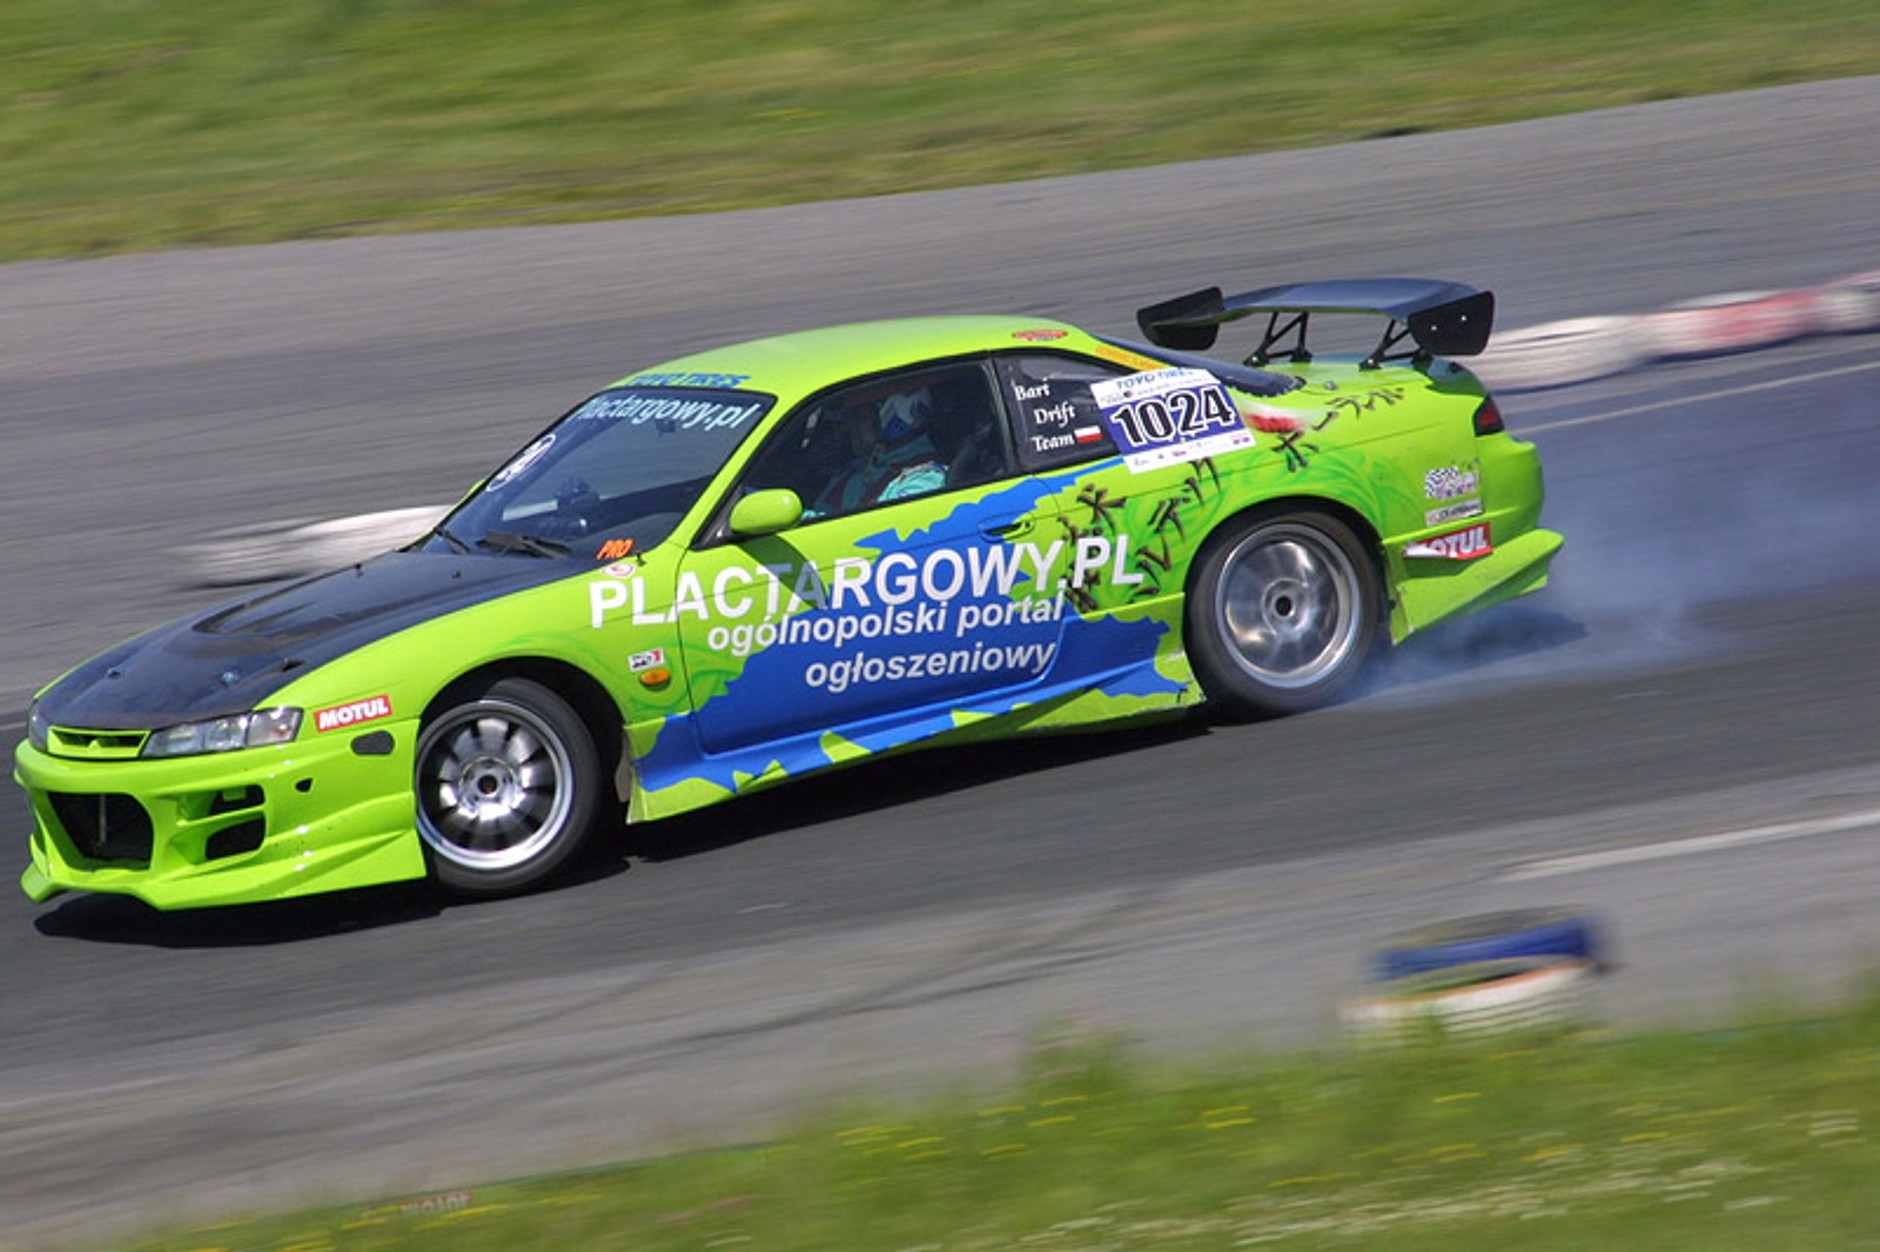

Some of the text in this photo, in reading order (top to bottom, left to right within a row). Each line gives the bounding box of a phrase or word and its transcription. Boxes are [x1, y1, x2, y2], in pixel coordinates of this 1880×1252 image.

[1014, 382, 1050, 401] Bart
[1034, 401, 1076, 427] Drift
[1111, 386, 1234, 446] 1024
[1032, 431, 1075, 451] Team
[1420, 526, 1487, 558] OTUL
[589, 534, 1145, 628] PLACTARGOWY.PL
[707, 590, 1066, 657] ogólnopolski portal
[805, 641, 1057, 693] ogłoszeniowy
[319, 697, 389, 730] MOTUL
